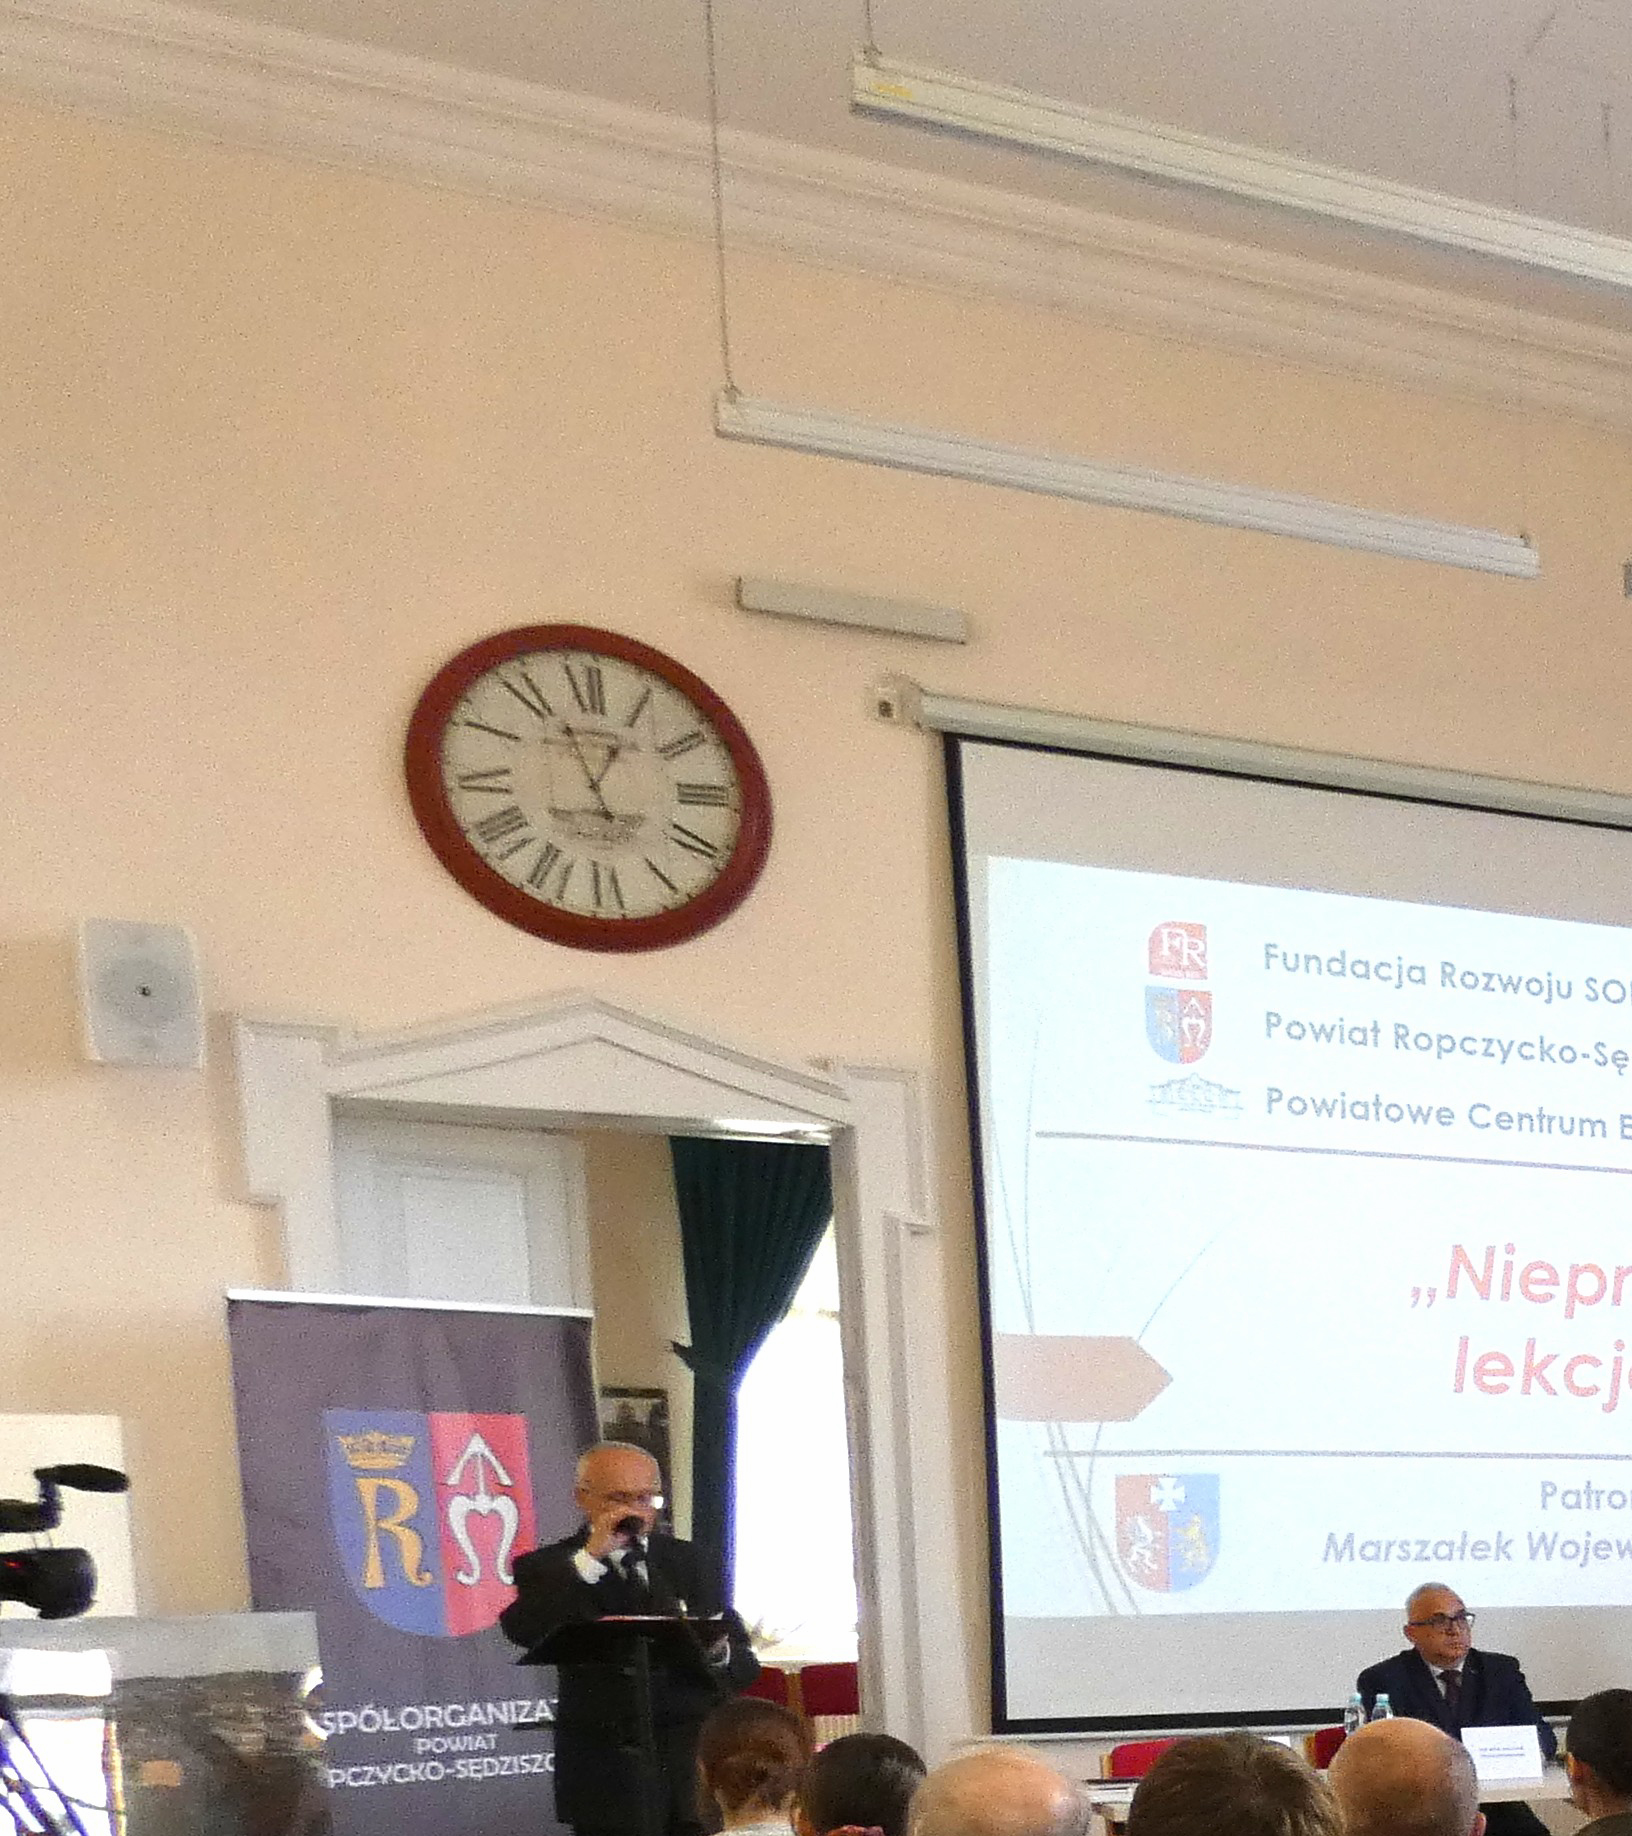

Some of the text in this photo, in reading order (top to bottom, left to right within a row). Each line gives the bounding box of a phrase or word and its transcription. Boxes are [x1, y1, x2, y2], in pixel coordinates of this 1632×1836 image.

[1264, 942, 1426, 990] Fundacja
[1440, 960, 1573, 1005] Rozwoju
[1265, 1010, 1381, 1048] Powiat
[1266, 1086, 1455, 1127] Powiatowe
[1468, 1102, 1607, 1139] Centrum
[1321, 1530, 1514, 1563] Marszałek
[320, 1699, 559, 1734] SPÓŁORGANIZA
[415, 1734, 498, 1755] POWIAT
[328, 1753, 555, 1789] PCZYCKO-SĘDZISZ
